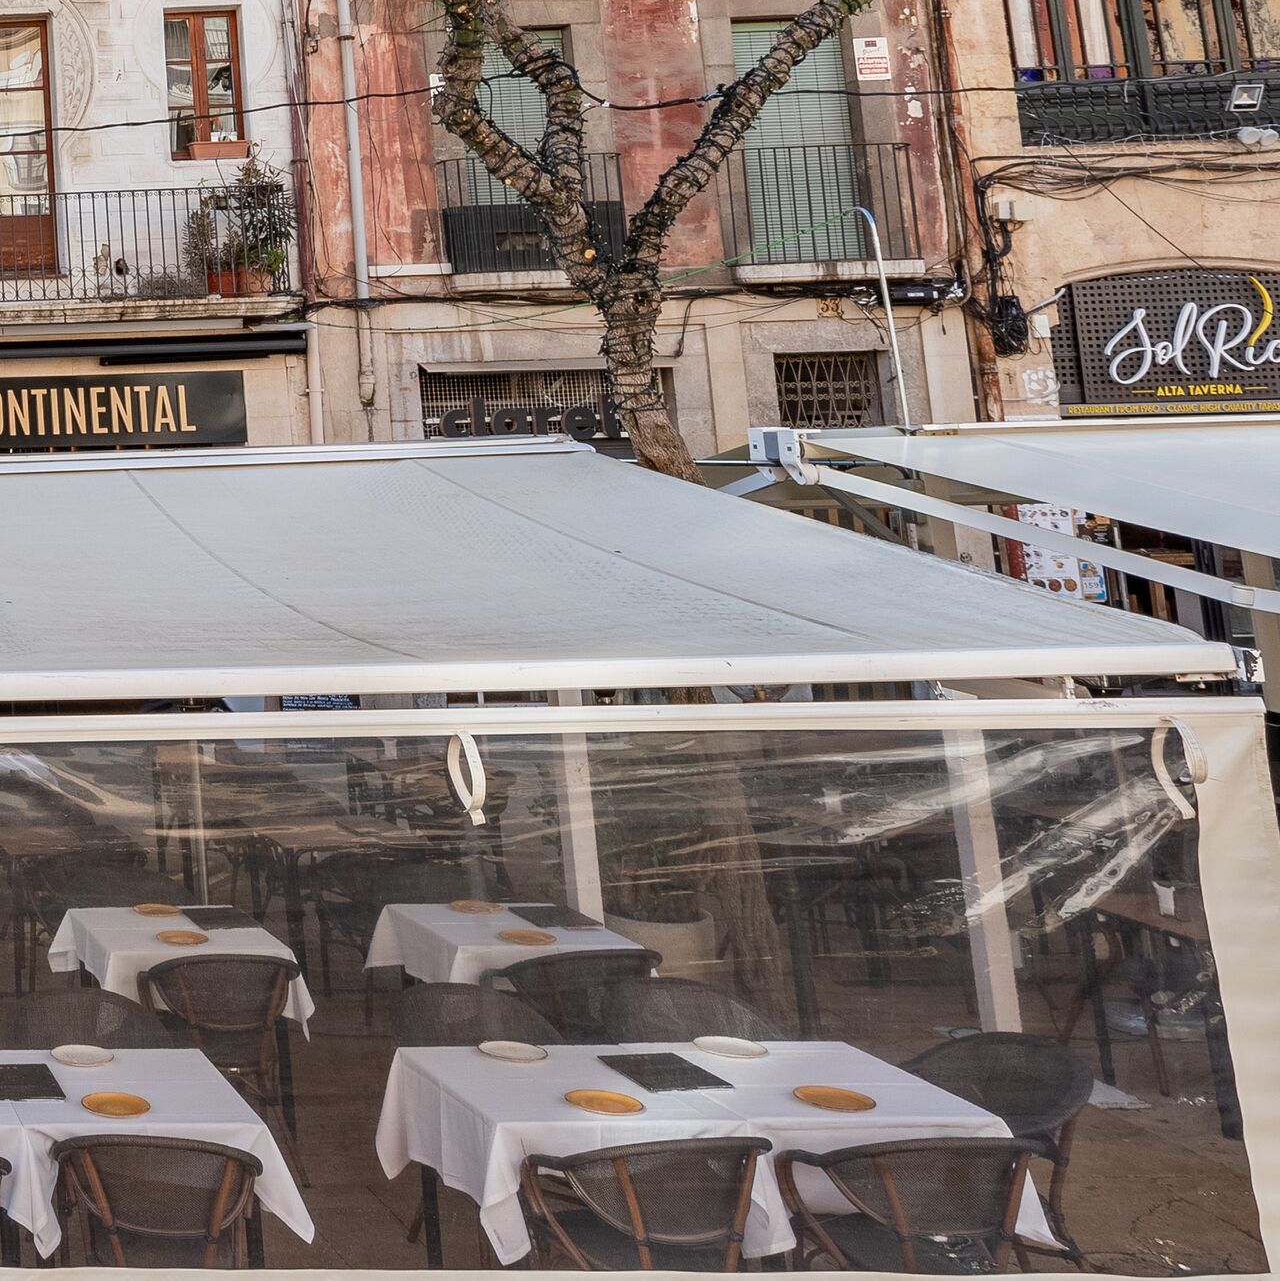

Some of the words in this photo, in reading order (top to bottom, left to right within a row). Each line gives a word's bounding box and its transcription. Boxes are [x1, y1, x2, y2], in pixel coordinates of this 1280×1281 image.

[1104, 302, 1197, 385] Sol
[1156, 385, 1185, 397] ALTA
[1189, 383, 1243, 396] TAVERNA
[1068, 405, 1113, 415] RESTAURANT
